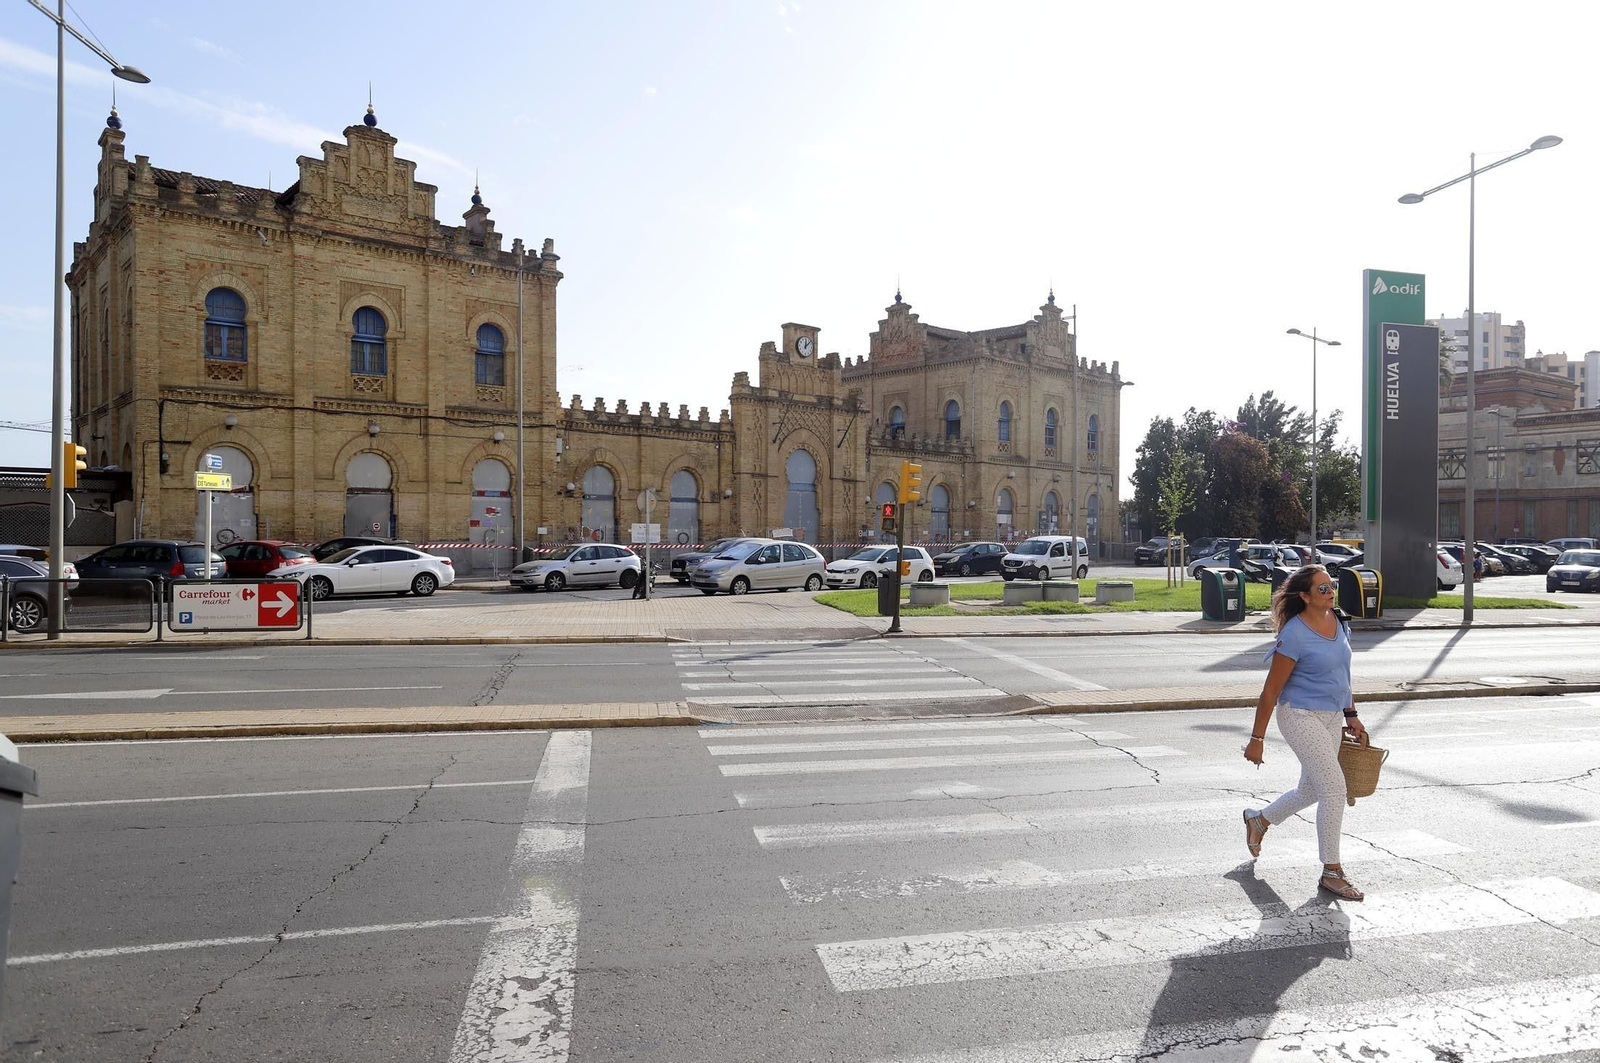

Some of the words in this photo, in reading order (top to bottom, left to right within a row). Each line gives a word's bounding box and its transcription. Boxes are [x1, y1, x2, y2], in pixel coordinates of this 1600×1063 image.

[1389, 283, 1421, 295] adif
[1387, 362, 1399, 420] HUELVA
[178, 589, 232, 599] Carrefour
[181, 614, 190, 622] P
